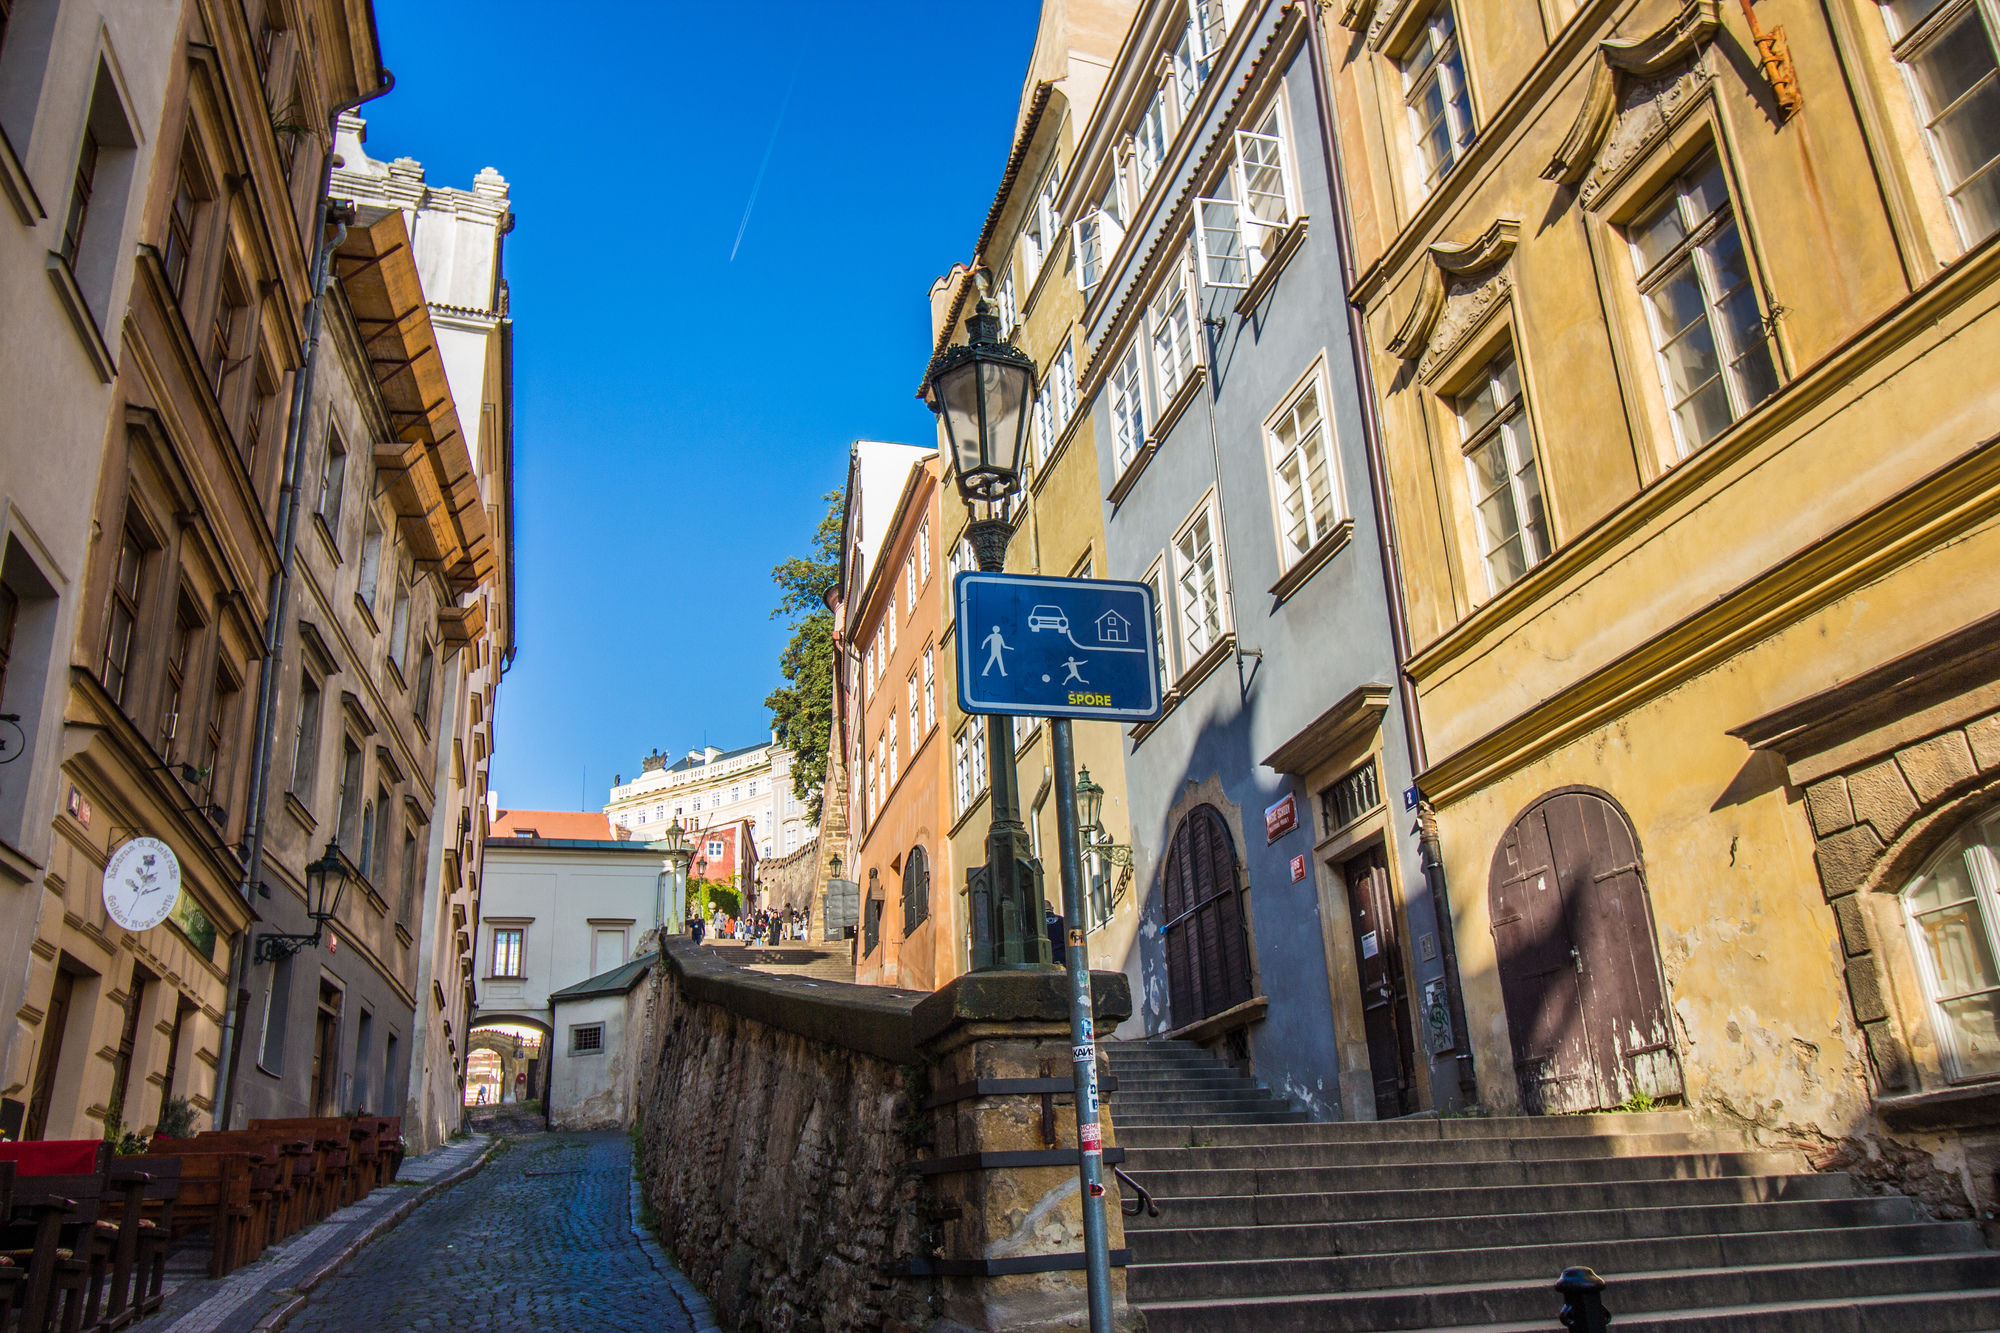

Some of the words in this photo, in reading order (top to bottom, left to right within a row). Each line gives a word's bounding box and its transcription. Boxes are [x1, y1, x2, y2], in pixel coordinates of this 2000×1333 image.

[1068, 694, 1111, 706] SPORE
[1406, 791, 1412, 804] 2
[107, 895, 129, 924] Golden
